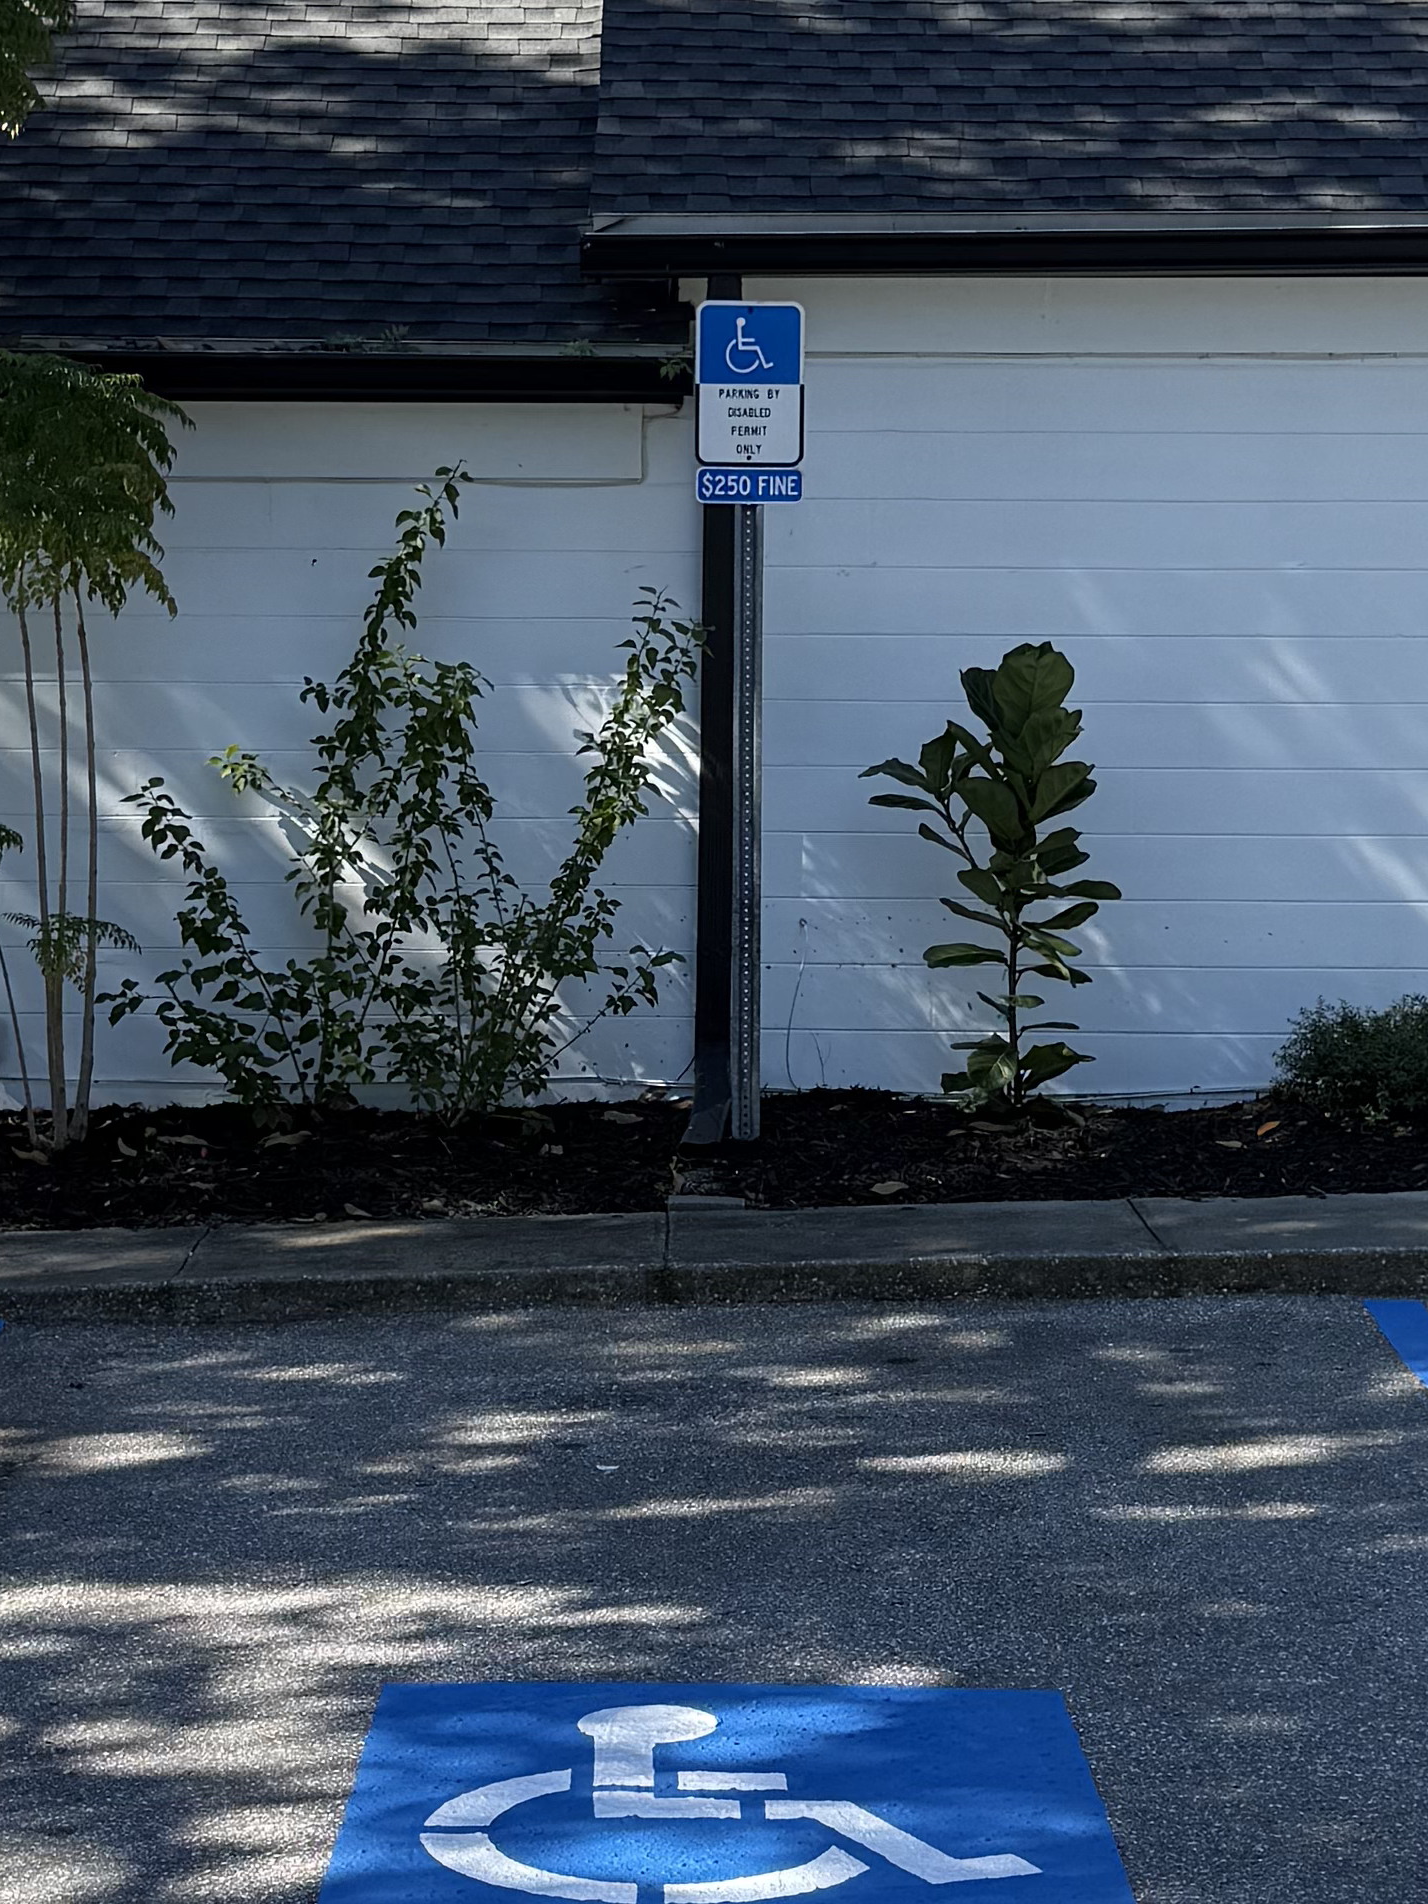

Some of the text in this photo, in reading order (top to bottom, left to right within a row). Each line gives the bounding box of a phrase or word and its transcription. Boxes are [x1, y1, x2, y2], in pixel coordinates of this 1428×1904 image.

[719, 388, 780, 399] PARKING BY
[728, 407, 771, 417] DISABLED
[731, 426, 767, 436] PERMIT
[736, 444, 762, 454] ONLY
[702, 473, 799, 497] $250 FINE
